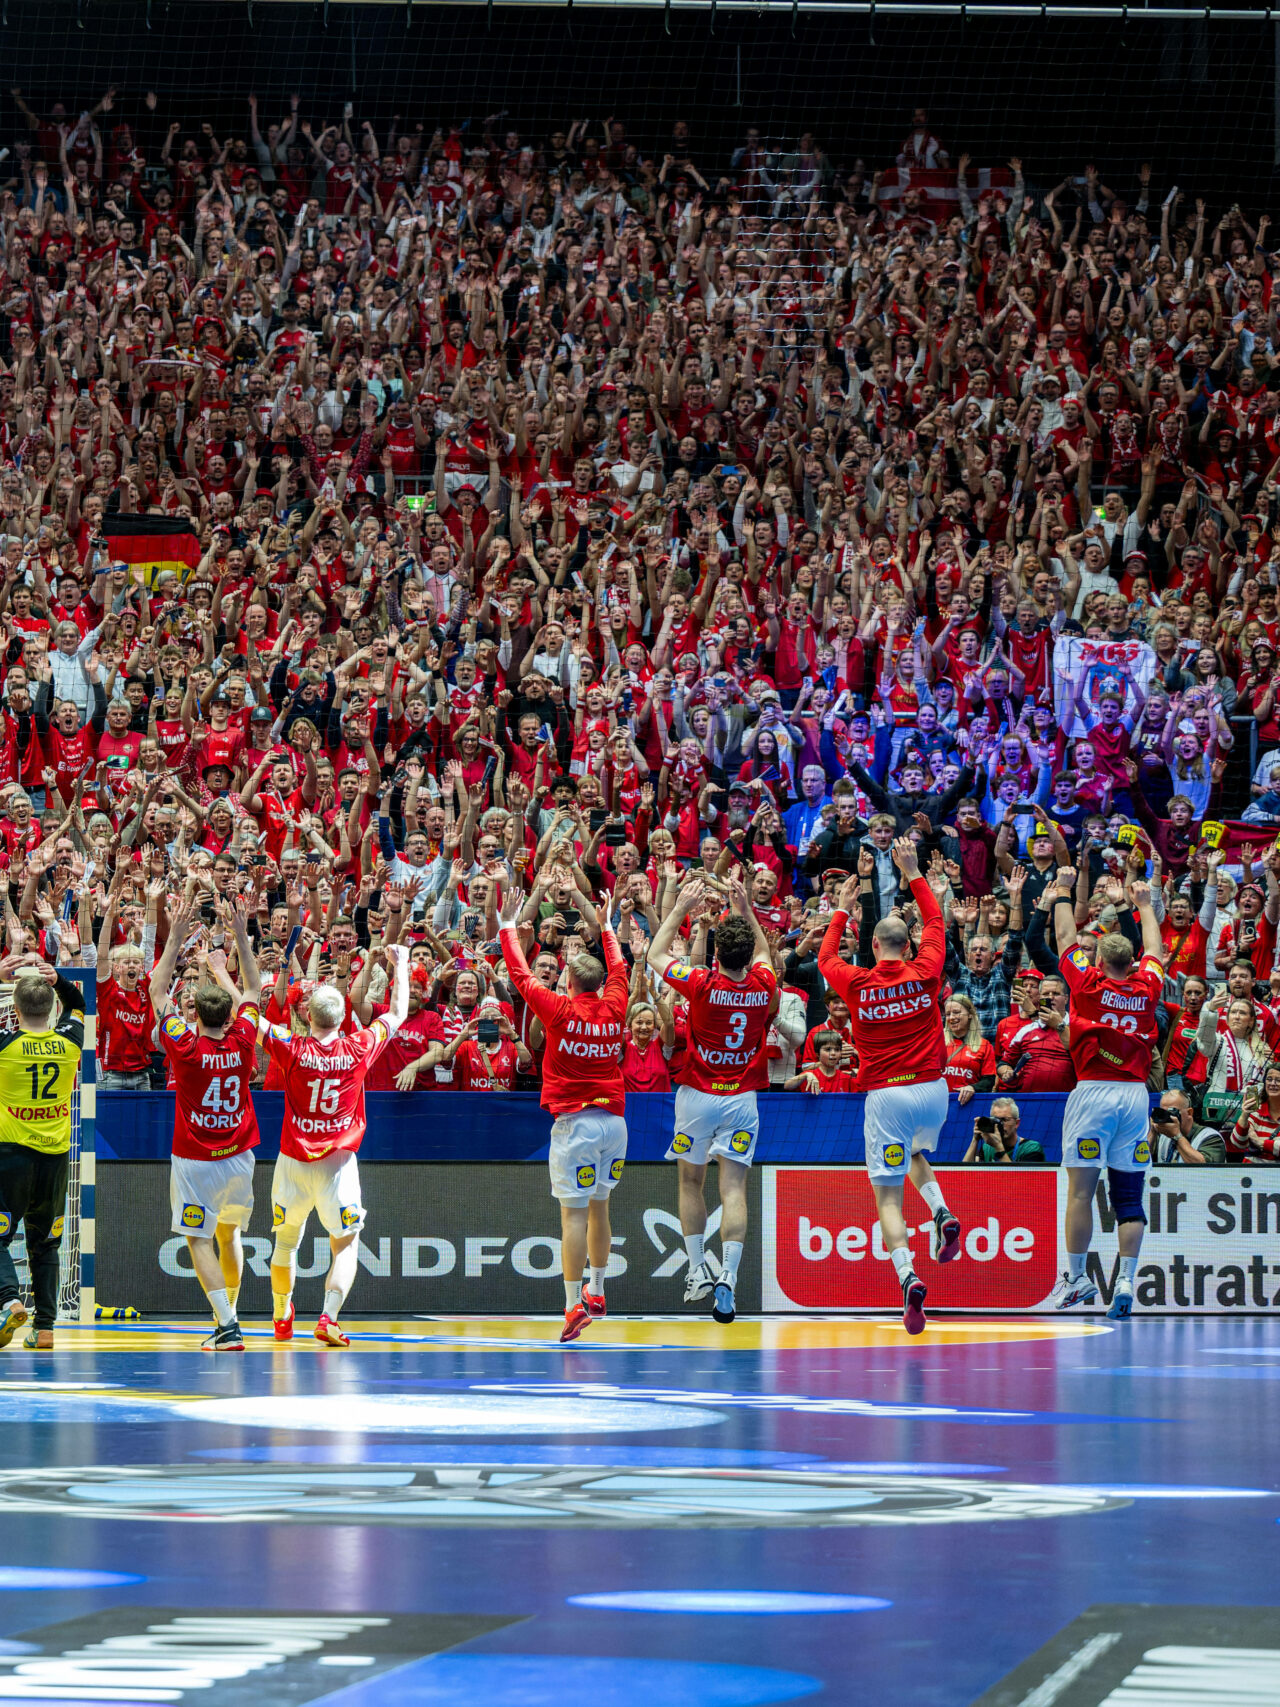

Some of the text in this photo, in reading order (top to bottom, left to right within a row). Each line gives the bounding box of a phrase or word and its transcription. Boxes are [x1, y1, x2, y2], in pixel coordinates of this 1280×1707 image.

[709, 988, 769, 1007] KIRKELØKKE
[860, 981, 924, 1003] DANMARK
[1101, 989, 1149, 1011] BERGHOLT
[858, 994, 932, 1021] NORLYS
[725, 1012, 748, 1049] 3
[22, 1040, 66, 1056] NIELSEN
[558, 1038, 621, 1059] NORLYS
[1098, 1047, 1124, 1066] BORUP
[202, 1051, 243, 1070] PYTLICK
[300, 1052, 355, 1071] SAUGSTRUP
[25, 1061, 61, 1100] 12
[711, 1082, 740, 1091] BORUP
[201, 1075, 241, 1113] 43
[307, 1078, 341, 1115] 15
[8, 1102, 70, 1121] NORLYS
[292, 1115, 353, 1134] NORLYS
[211, 1144, 239, 1157] BORUP
[158, 1236, 628, 1278] GRUNDFOS
[1083, 1251, 1280, 1307] Matrat
